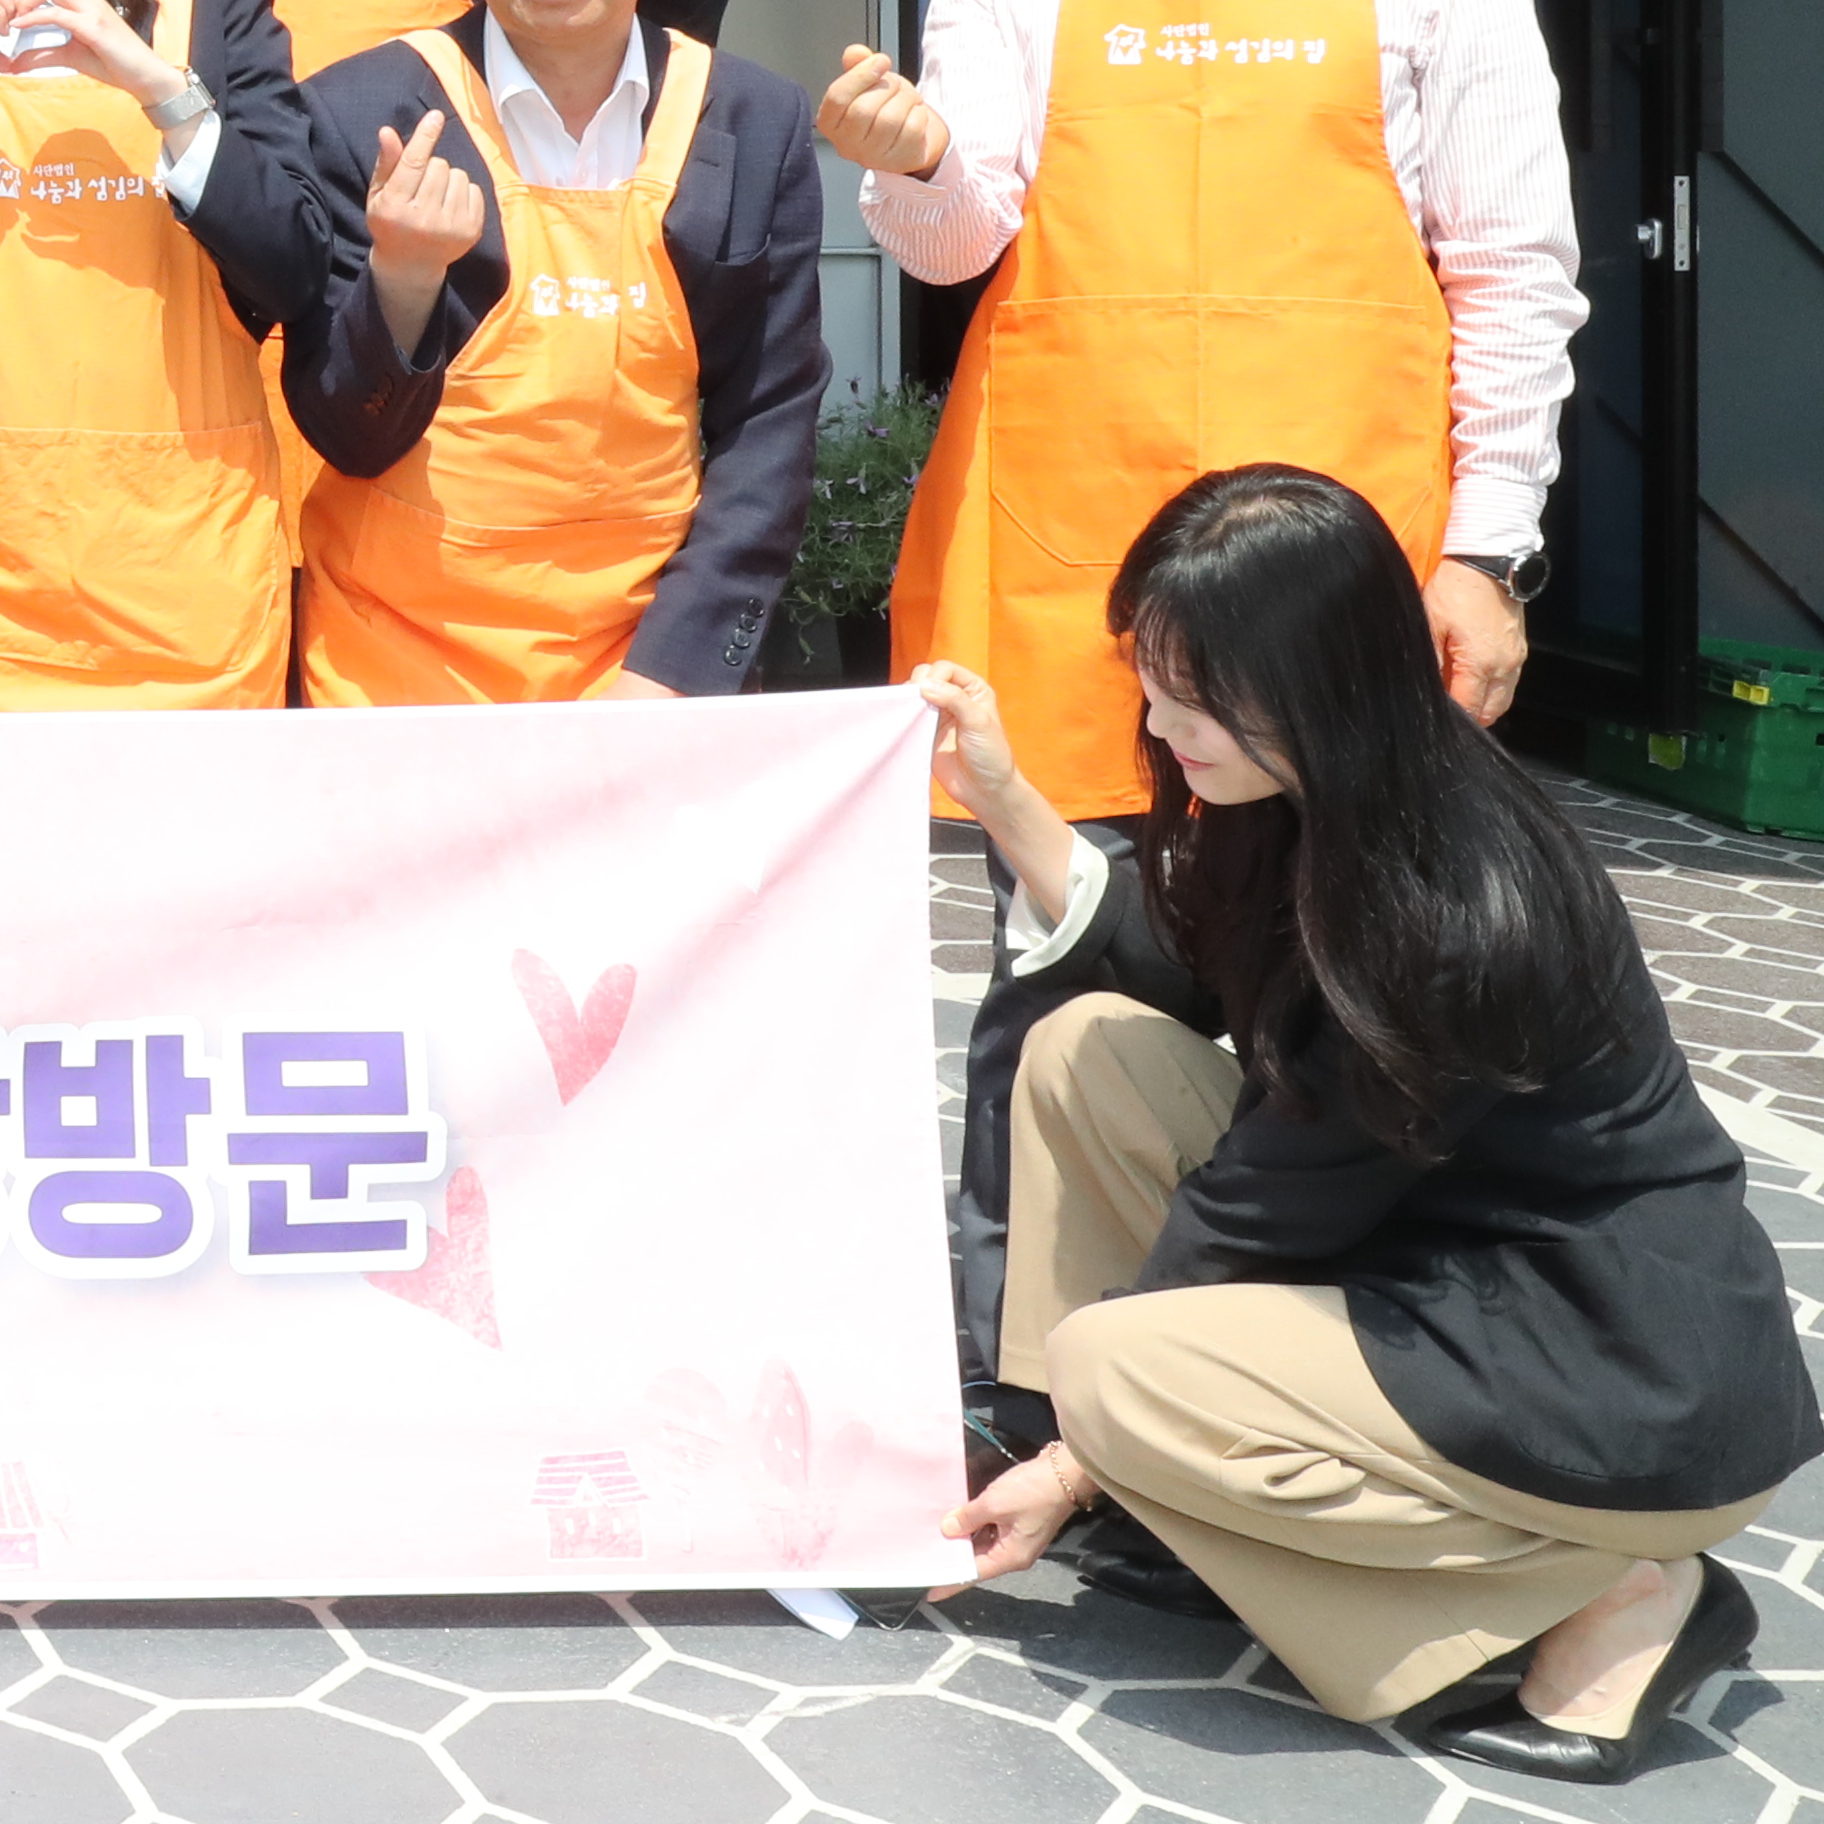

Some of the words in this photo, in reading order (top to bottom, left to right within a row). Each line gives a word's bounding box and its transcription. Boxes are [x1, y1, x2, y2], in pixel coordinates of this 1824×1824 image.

[1155, 39, 1219, 66] 나눔과
[1224, 38, 1295, 64] 섬김의
[1302, 38, 1326, 64] 집
[33, 163, 75, 177] 사단법인
[30, 176, 83, 204] 나눔과
[87, 176, 145, 201] 섬김의
[628, 282, 647, 309] 집
